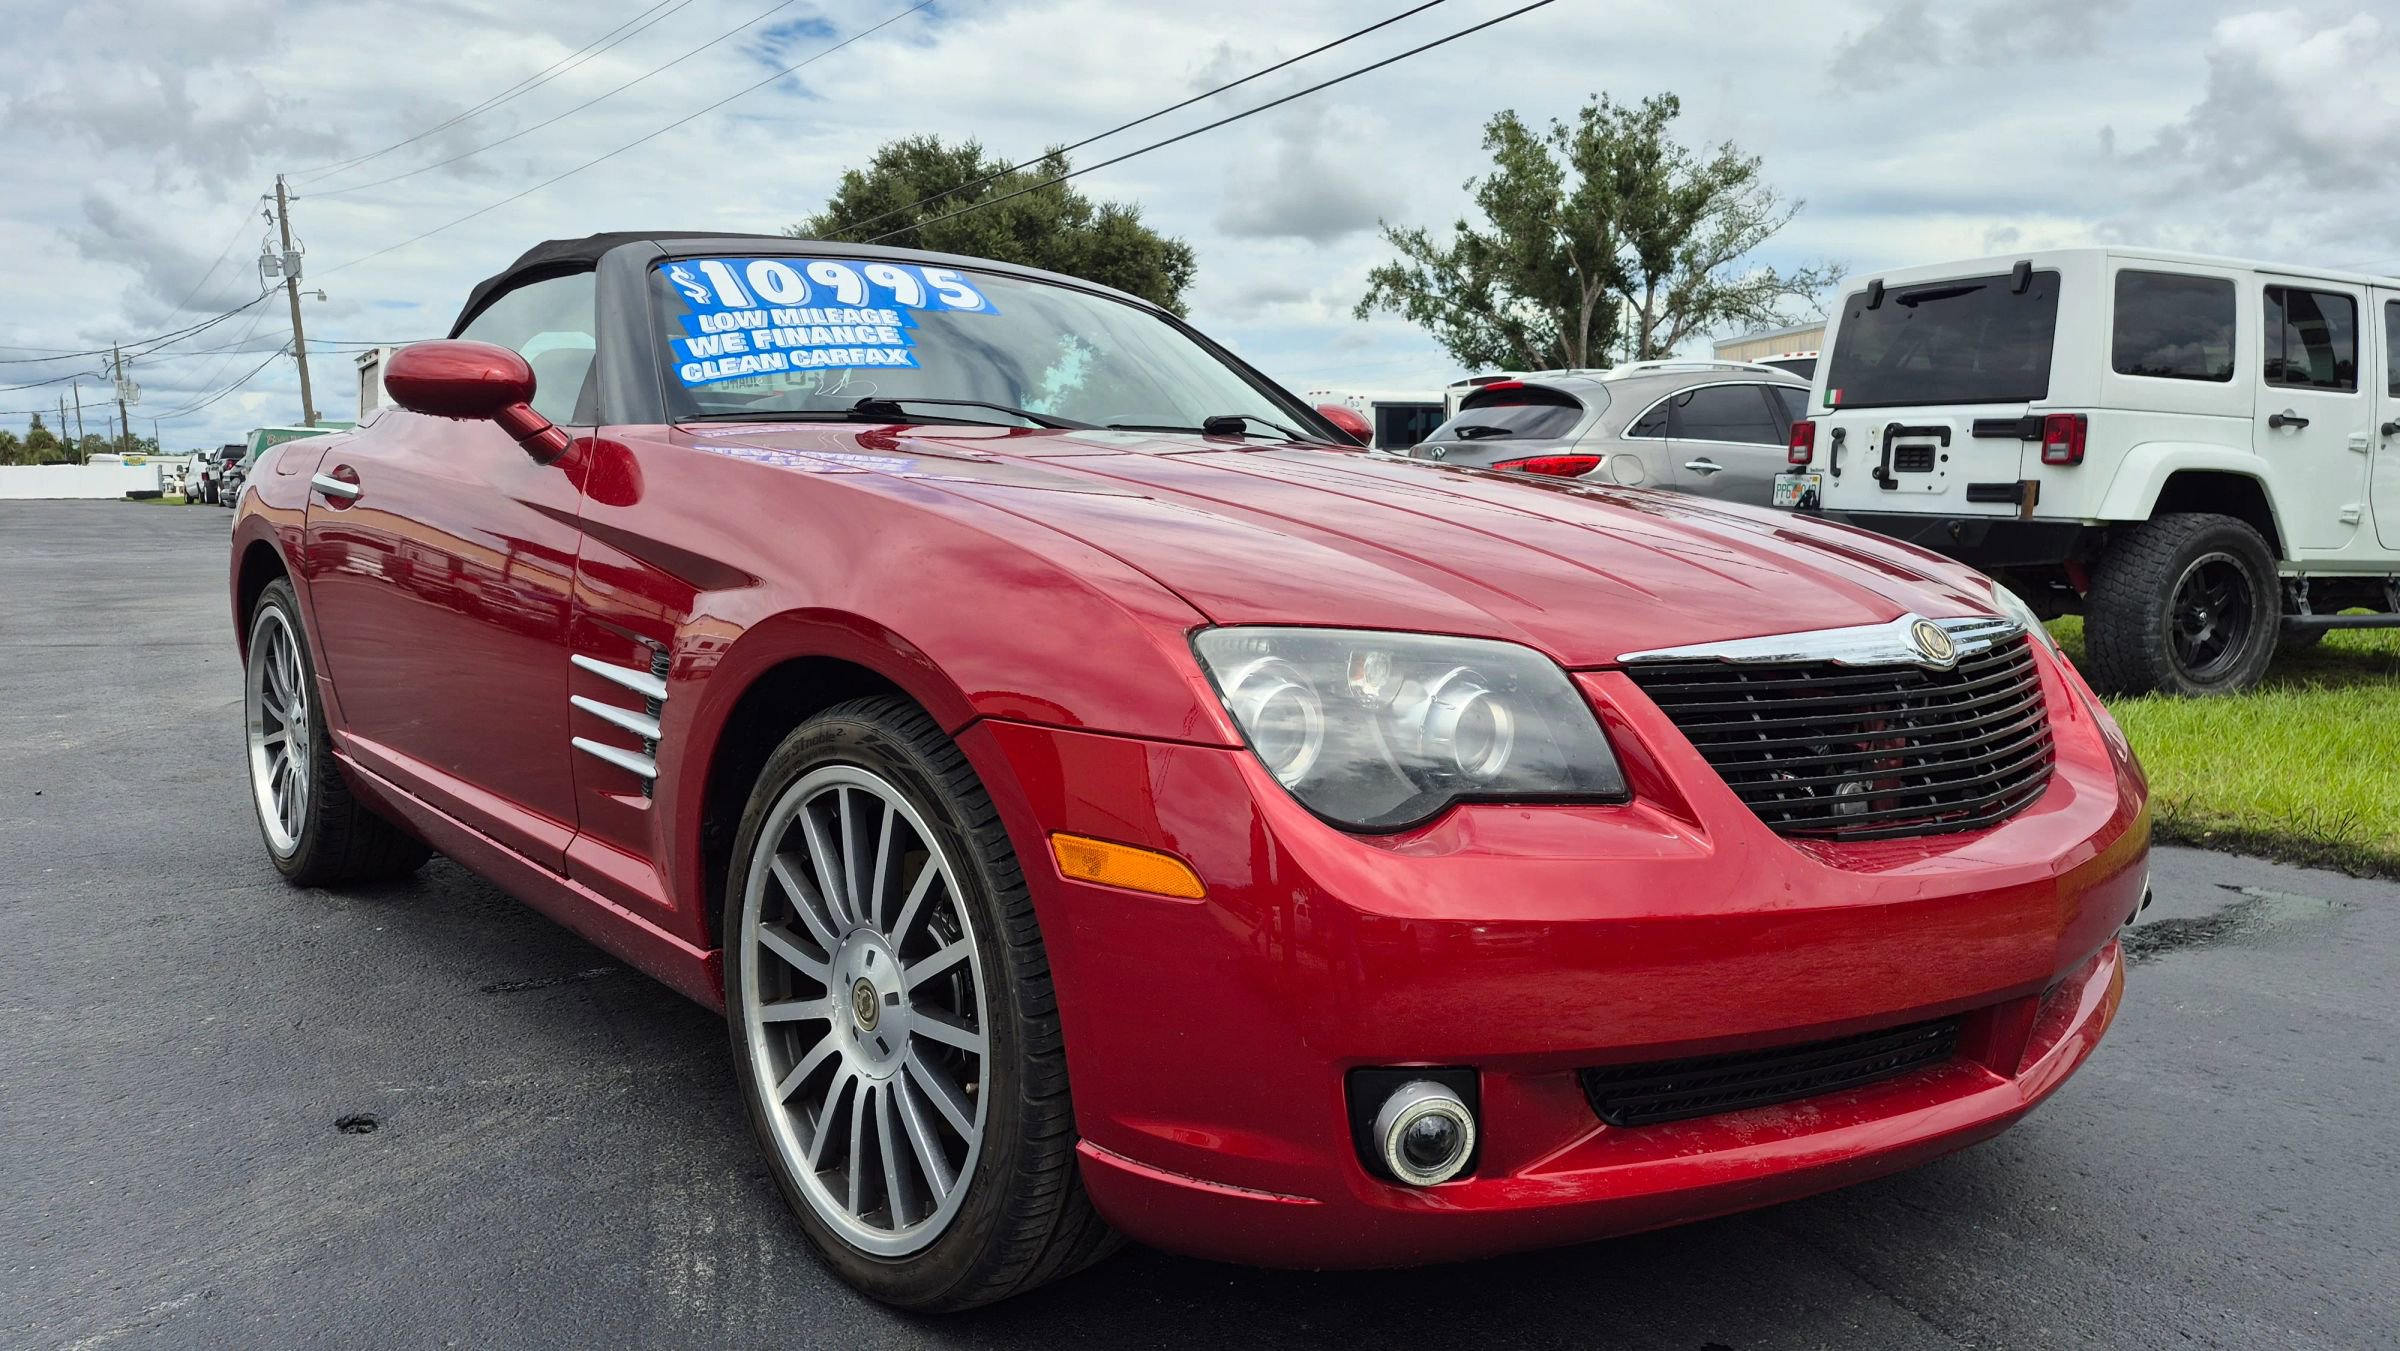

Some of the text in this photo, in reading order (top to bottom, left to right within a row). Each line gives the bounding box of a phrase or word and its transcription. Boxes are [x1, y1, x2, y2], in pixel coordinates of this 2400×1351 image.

[670, 259, 987, 310] $10995
[699, 307, 903, 334] LOW MILEAGE
[684, 326, 904, 359] WE FINANCE
[681, 351, 790, 383] CLEAN
[789, 347, 912, 368] CARFAX
